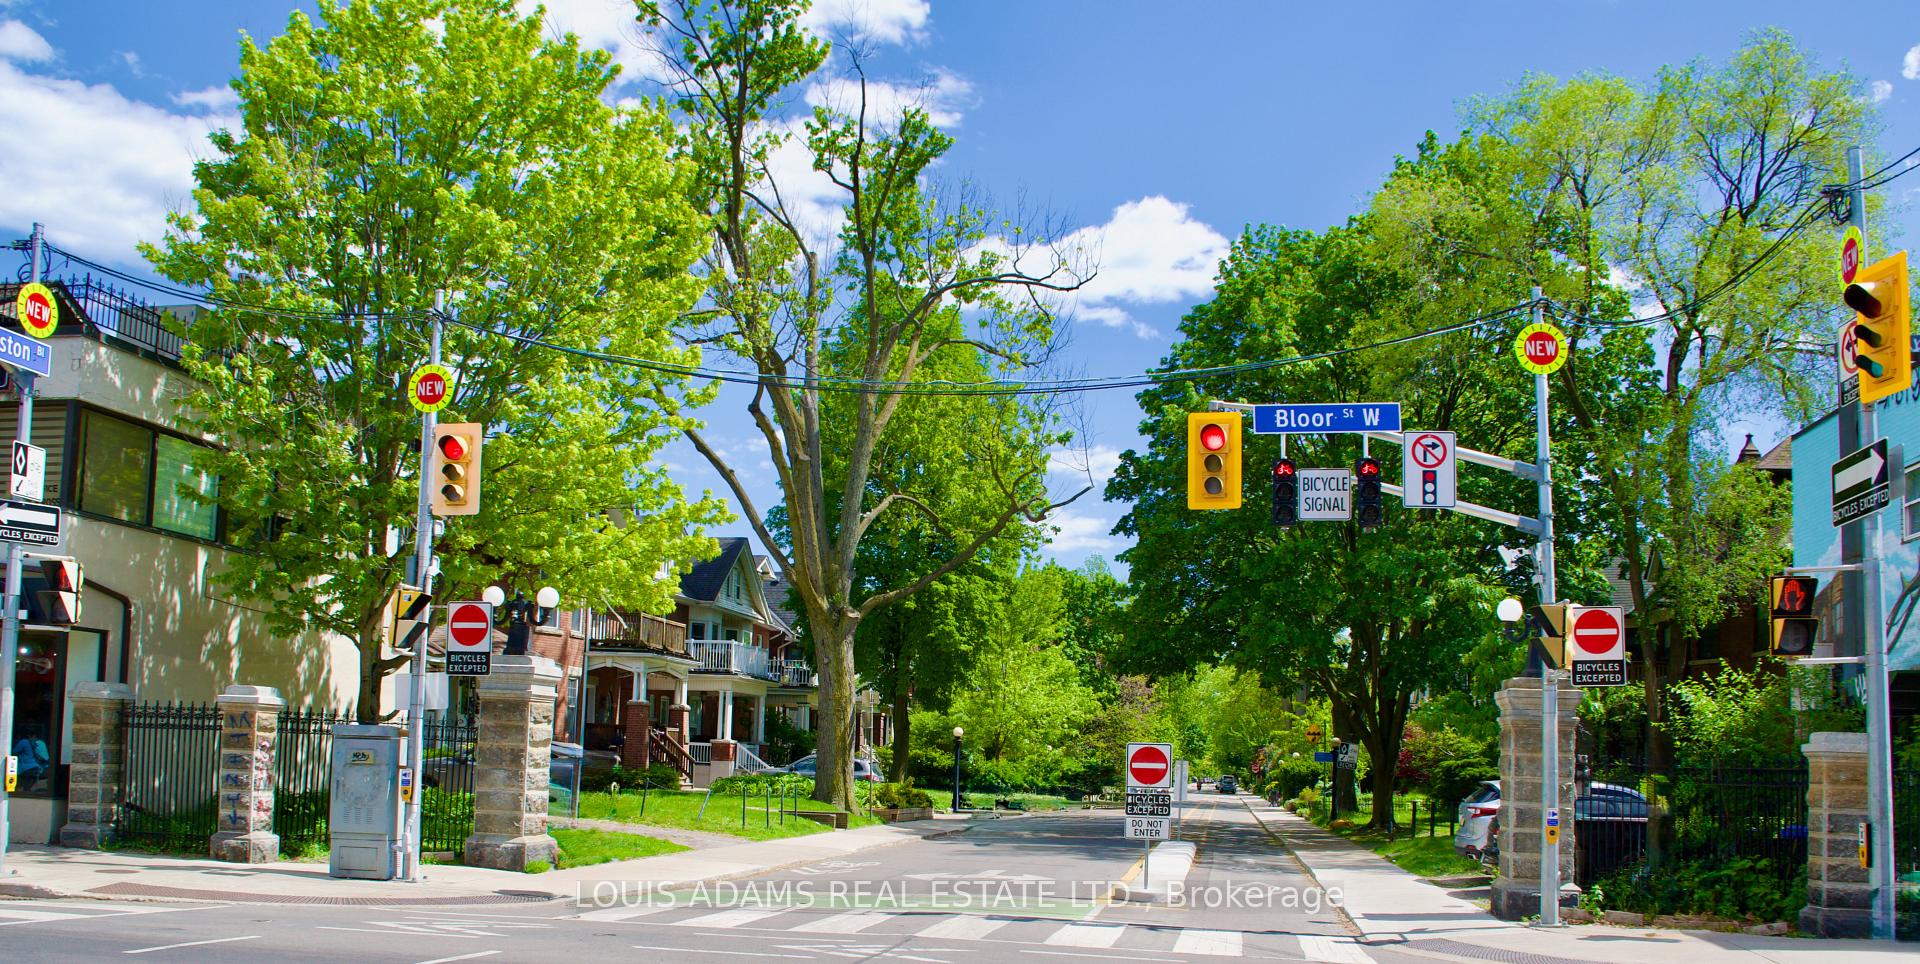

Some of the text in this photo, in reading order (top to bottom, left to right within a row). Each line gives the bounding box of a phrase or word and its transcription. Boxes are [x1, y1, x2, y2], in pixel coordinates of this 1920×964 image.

[1843, 246, 1857, 275] NEW
[26, 298, 50, 323] NEW
[1525, 340, 1556, 356] NEW
[417, 380, 444, 396] NEW
[1276, 408, 1380, 427] Bloor St W
[1302, 476, 1348, 492] BICYCLE
[1304, 497, 1346, 512] SIGNAL
[1834, 488, 1889, 521] BICYCLES EXCEPTED
[23, 531, 59, 543] EXCEPTED
[450, 654, 487, 662] BICYCLES
[449, 664, 488, 672] EXCEPTED
[1576, 663, 1620, 672] BICYCLES
[1575, 674, 1622, 682] EXCEPTED
[1128, 795, 1170, 804] BICYCLES
[1127, 806, 1169, 815] EXCEPTED
[1131, 819, 1163, 829] DO NOT
[1134, 828, 1161, 837] ENTER
